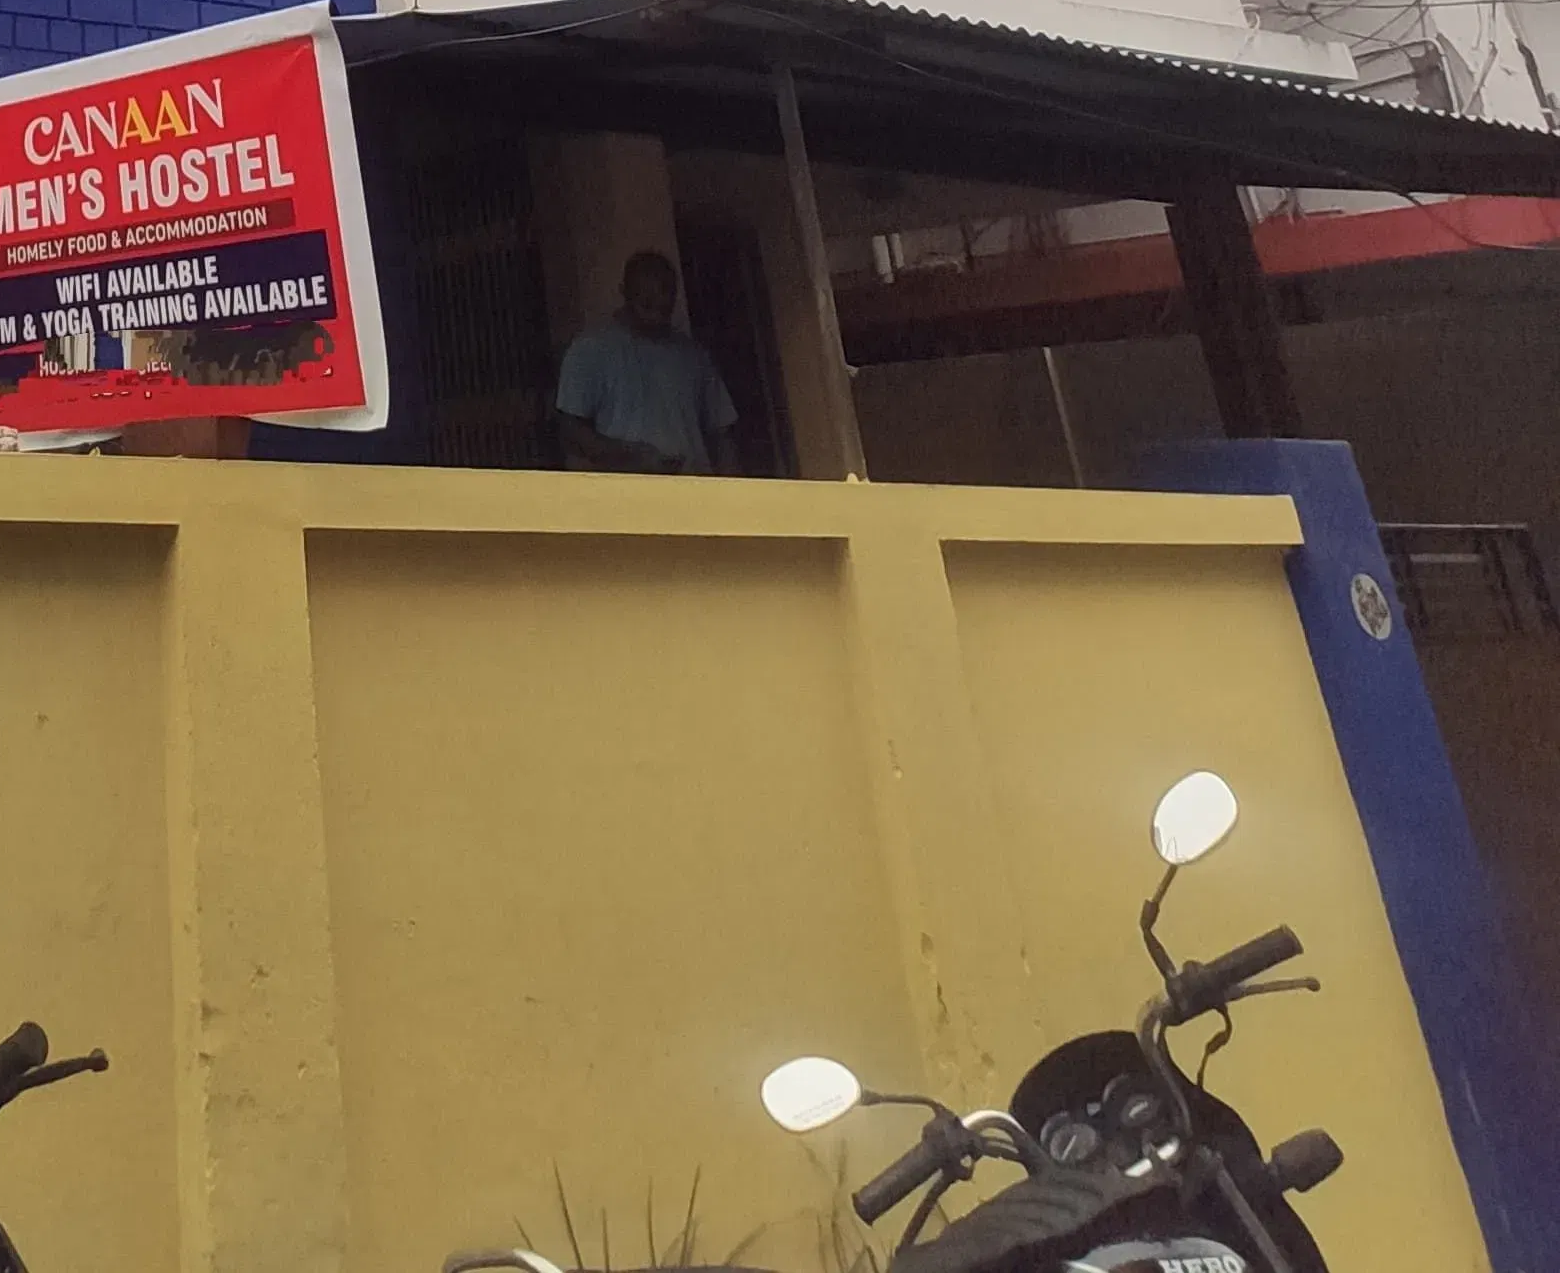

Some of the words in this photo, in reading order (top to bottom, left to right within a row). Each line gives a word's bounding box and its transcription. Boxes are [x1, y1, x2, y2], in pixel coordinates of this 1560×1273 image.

[24, 78, 225, 165] CANAAN
[118, 134, 295, 214] HOSTEL
[7, 239, 64, 266] HOMELY
[67, 232, 107, 256] FOOD
[111, 229, 122, 250] &
[125, 207, 268, 247] ACCOMMODATION
[23, 310, 38, 342] &
[41, 303, 95, 340] YOGA
[98, 293, 198, 333] TRAINING
[204, 275, 329, 319] AVAILABLE
[56, 273, 101, 305] WIFI
[107, 255, 219, 299] AVAILABLE
